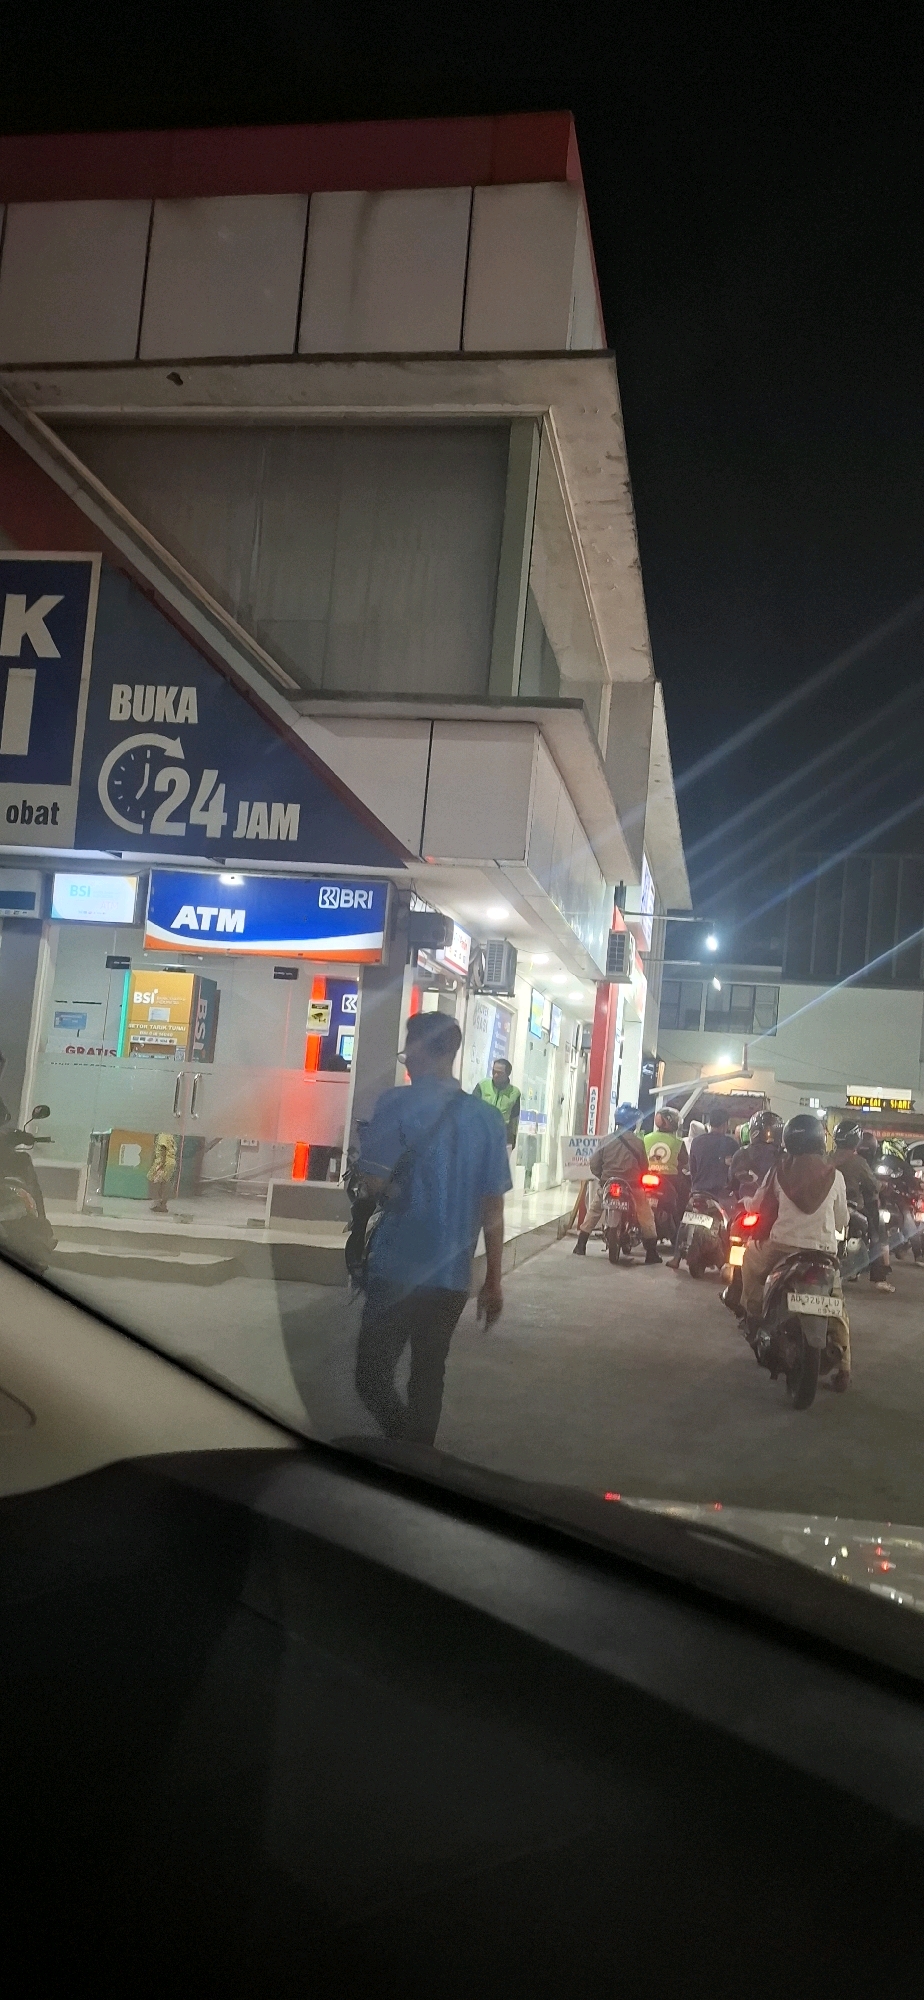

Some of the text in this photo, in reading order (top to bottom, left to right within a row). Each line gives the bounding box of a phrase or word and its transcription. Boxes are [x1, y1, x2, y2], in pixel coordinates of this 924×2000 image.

[109, 683, 198, 724] BUKA
[6, 800, 60, 826] obat
[149, 766, 300, 841] 24 JAM
[69, 884, 91, 898] BSI
[339, 889, 374, 909] BRI
[170, 905, 246, 934] ATM
[133, 990, 156, 1004] BSI
[193, 999, 208, 1051] BSI
[588, 1089, 597, 1133] APOTEK
[568, 1138, 602, 1148] APOT
